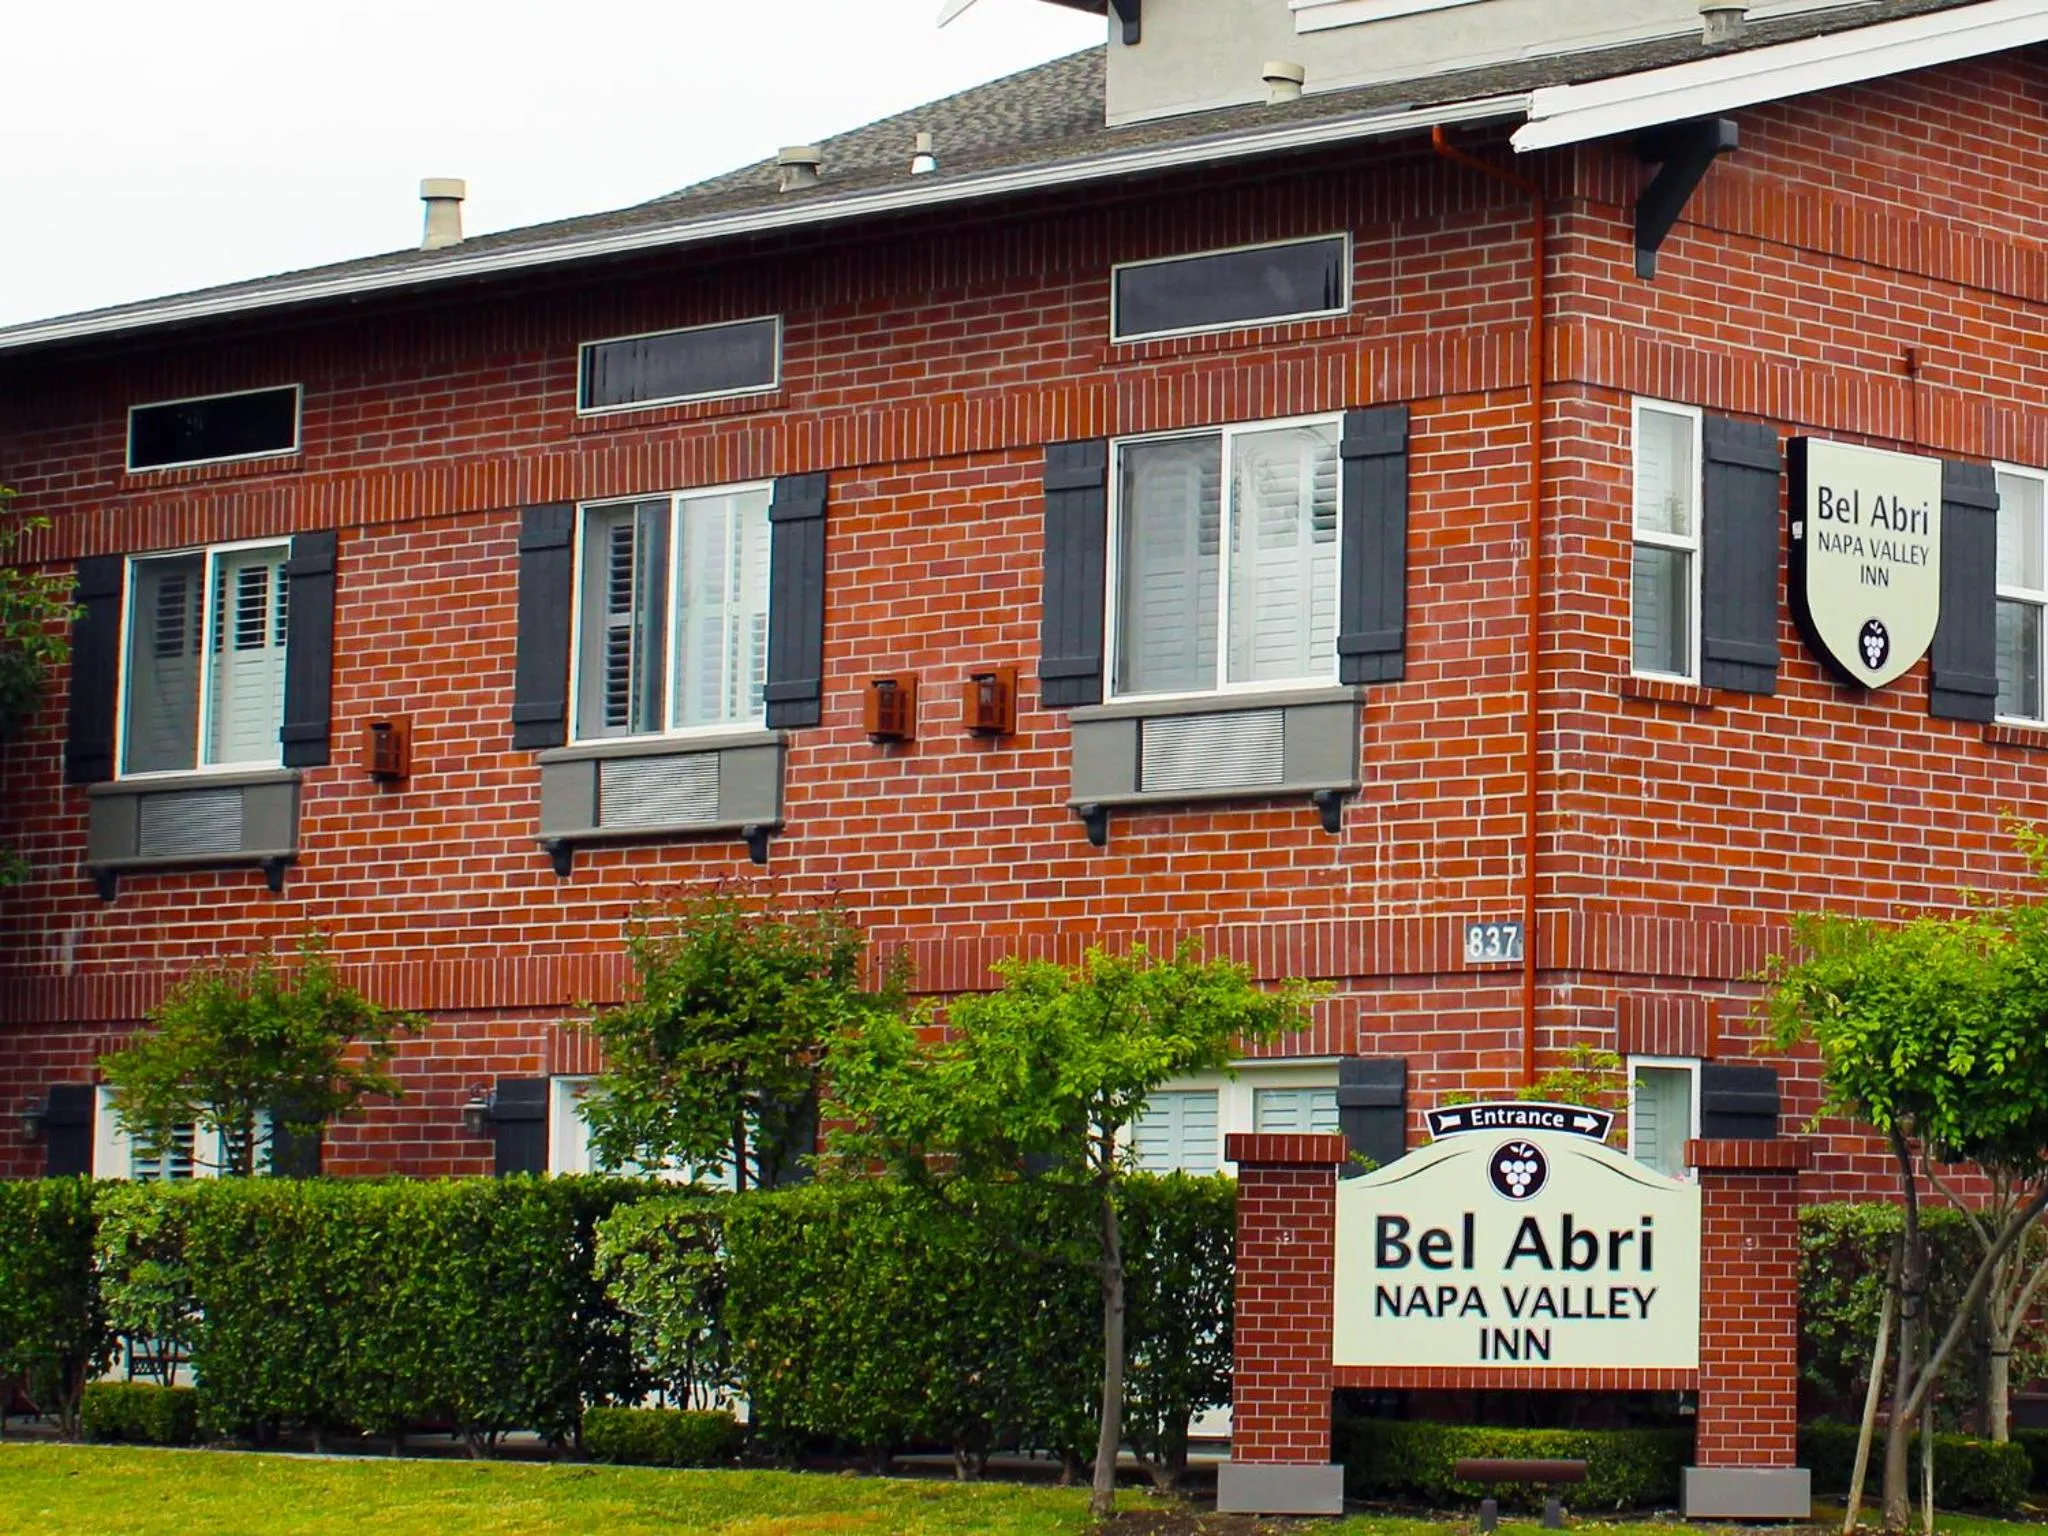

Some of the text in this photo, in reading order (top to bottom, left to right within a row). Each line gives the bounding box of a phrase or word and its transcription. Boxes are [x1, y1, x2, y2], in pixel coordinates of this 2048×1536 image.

[1818, 486, 1928, 535] Bel Abri
[1818, 531, 1929, 566] NAPA VALLEY
[1860, 564, 1889, 587] INN
[1470, 926, 1518, 957] 837
[1471, 1108, 1565, 1129] Entrance
[1374, 1212, 1654, 1271] Bel Abri
[1374, 1285, 1658, 1319] NAPA VALLEY
[1480, 1328, 1552, 1361] INN
